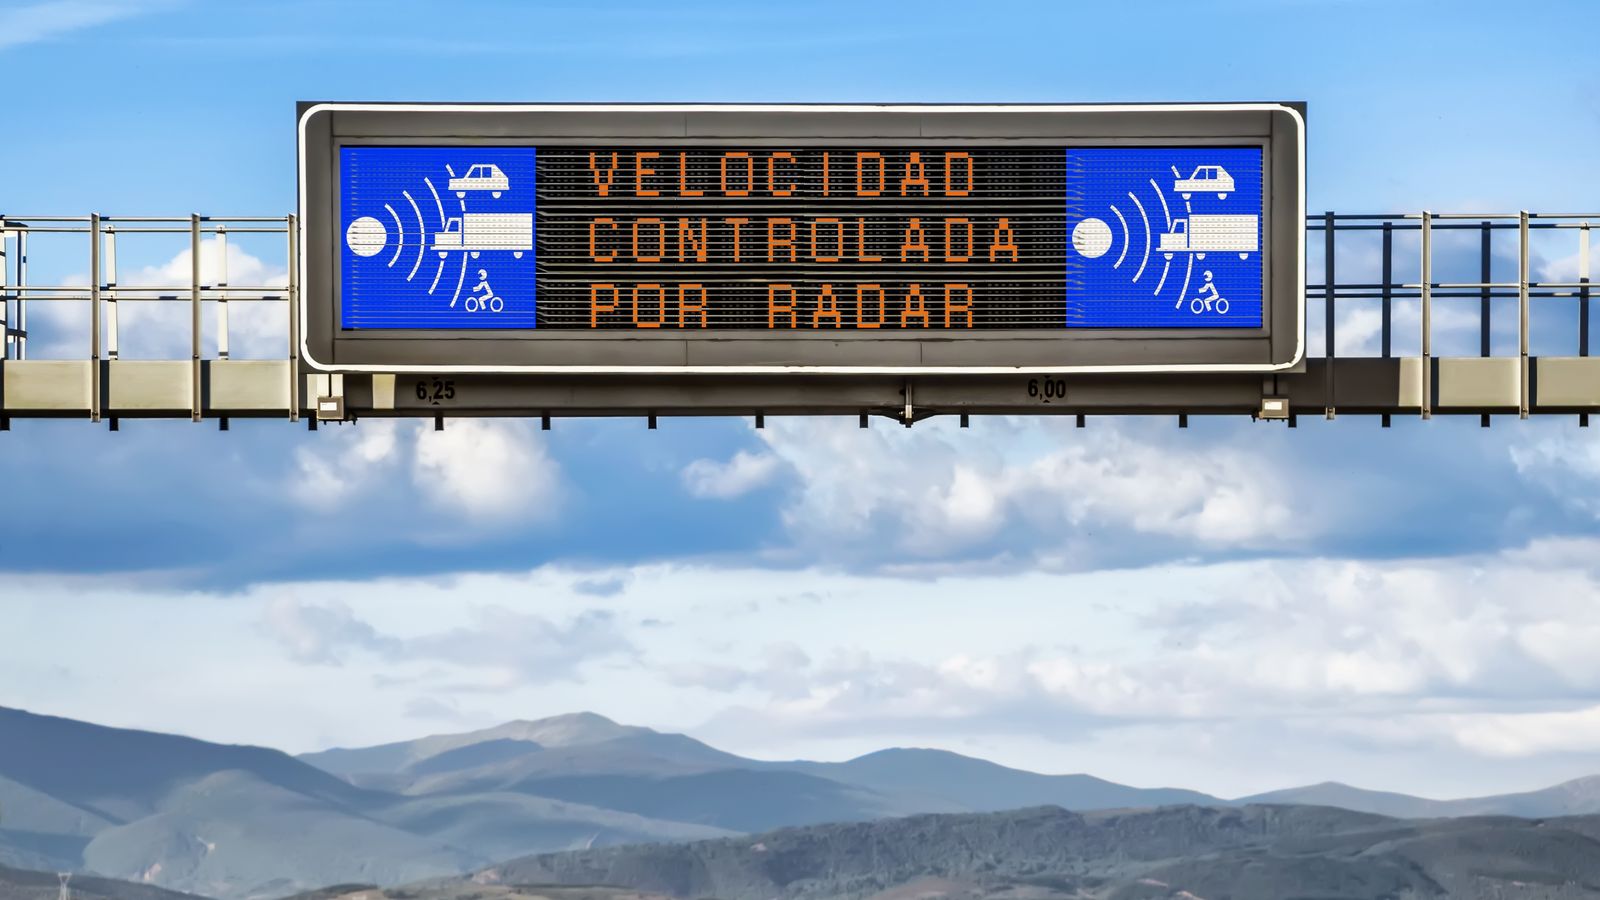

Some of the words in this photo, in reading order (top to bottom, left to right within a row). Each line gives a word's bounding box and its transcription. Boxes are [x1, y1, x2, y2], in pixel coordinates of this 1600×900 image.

[590, 152, 973, 196] VELOCIDAD
[590, 217, 1017, 261] CONTROLADA
[591, 283, 706, 328] POR
[768, 283, 972, 328] RADAR
[416, 381, 456, 402] 6,25
[1028, 379, 1066, 400] 6,00
